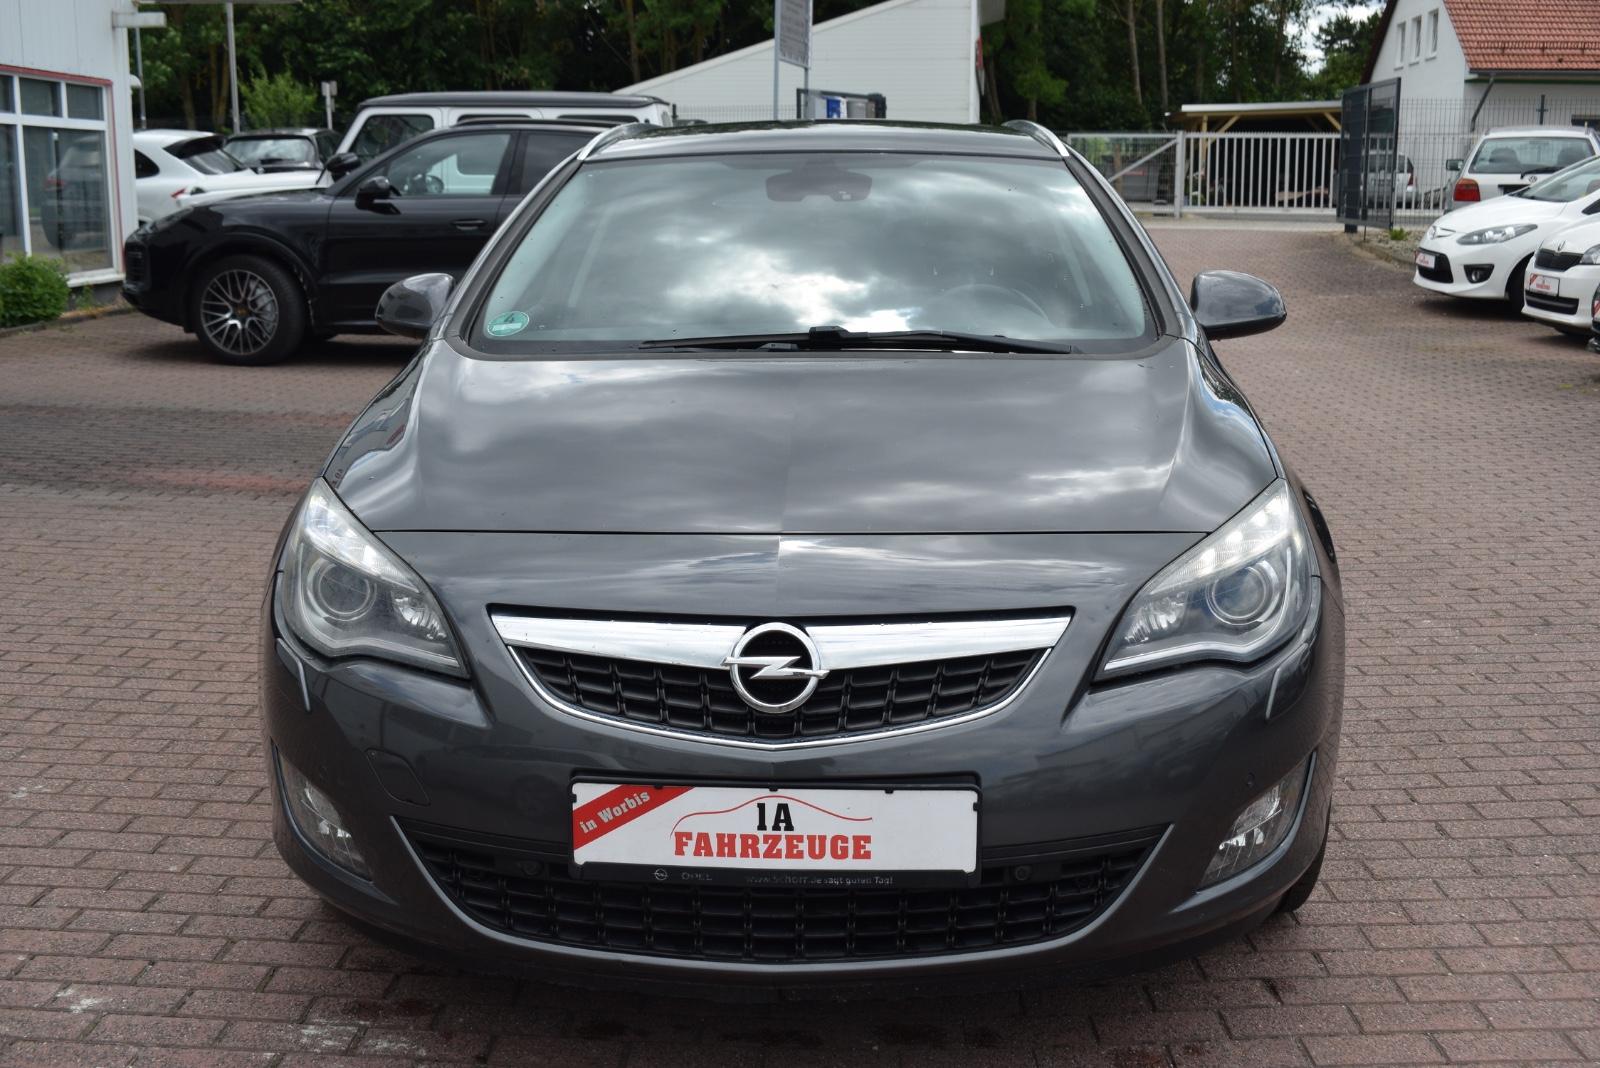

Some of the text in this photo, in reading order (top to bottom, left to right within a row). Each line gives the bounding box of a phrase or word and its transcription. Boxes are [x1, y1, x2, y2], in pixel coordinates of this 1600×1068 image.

[580, 791, 651, 834] in Worbis
[674, 831, 872, 860] FAHRZEUGE
